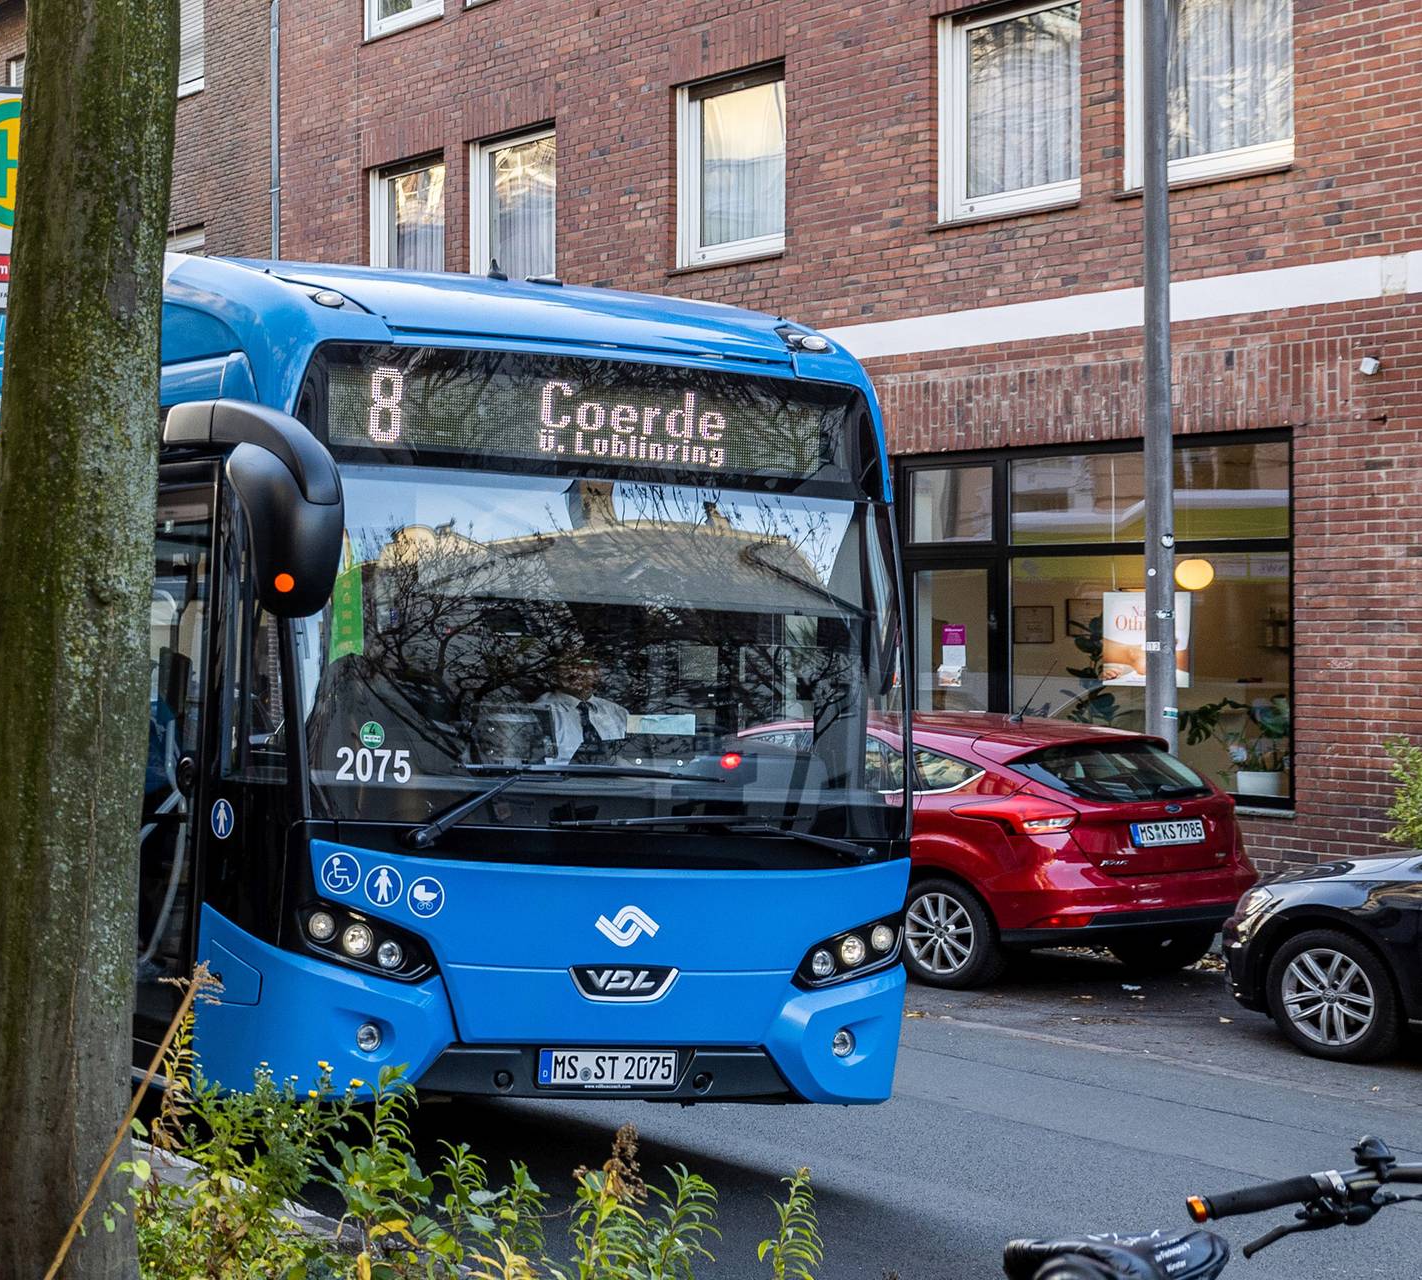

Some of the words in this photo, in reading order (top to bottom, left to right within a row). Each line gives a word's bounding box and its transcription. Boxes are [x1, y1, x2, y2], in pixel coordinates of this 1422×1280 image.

[368, 367, 404, 443] 8
[540, 379, 727, 441] Coerde
[575, 430, 726, 468] Lublinring
[369, 723, 376, 735] 4
[335, 746, 412, 784] 2075
[1139, 824, 1155, 841] MS
[1162, 823, 1177, 840] KS
[1177, 821, 1203, 839] 7985
[586, 969, 656, 991] VDL
[553, 1055, 579, 1080] MS
[594, 1055, 619, 1080] ST
[624, 1056, 673, 1080] 2075
